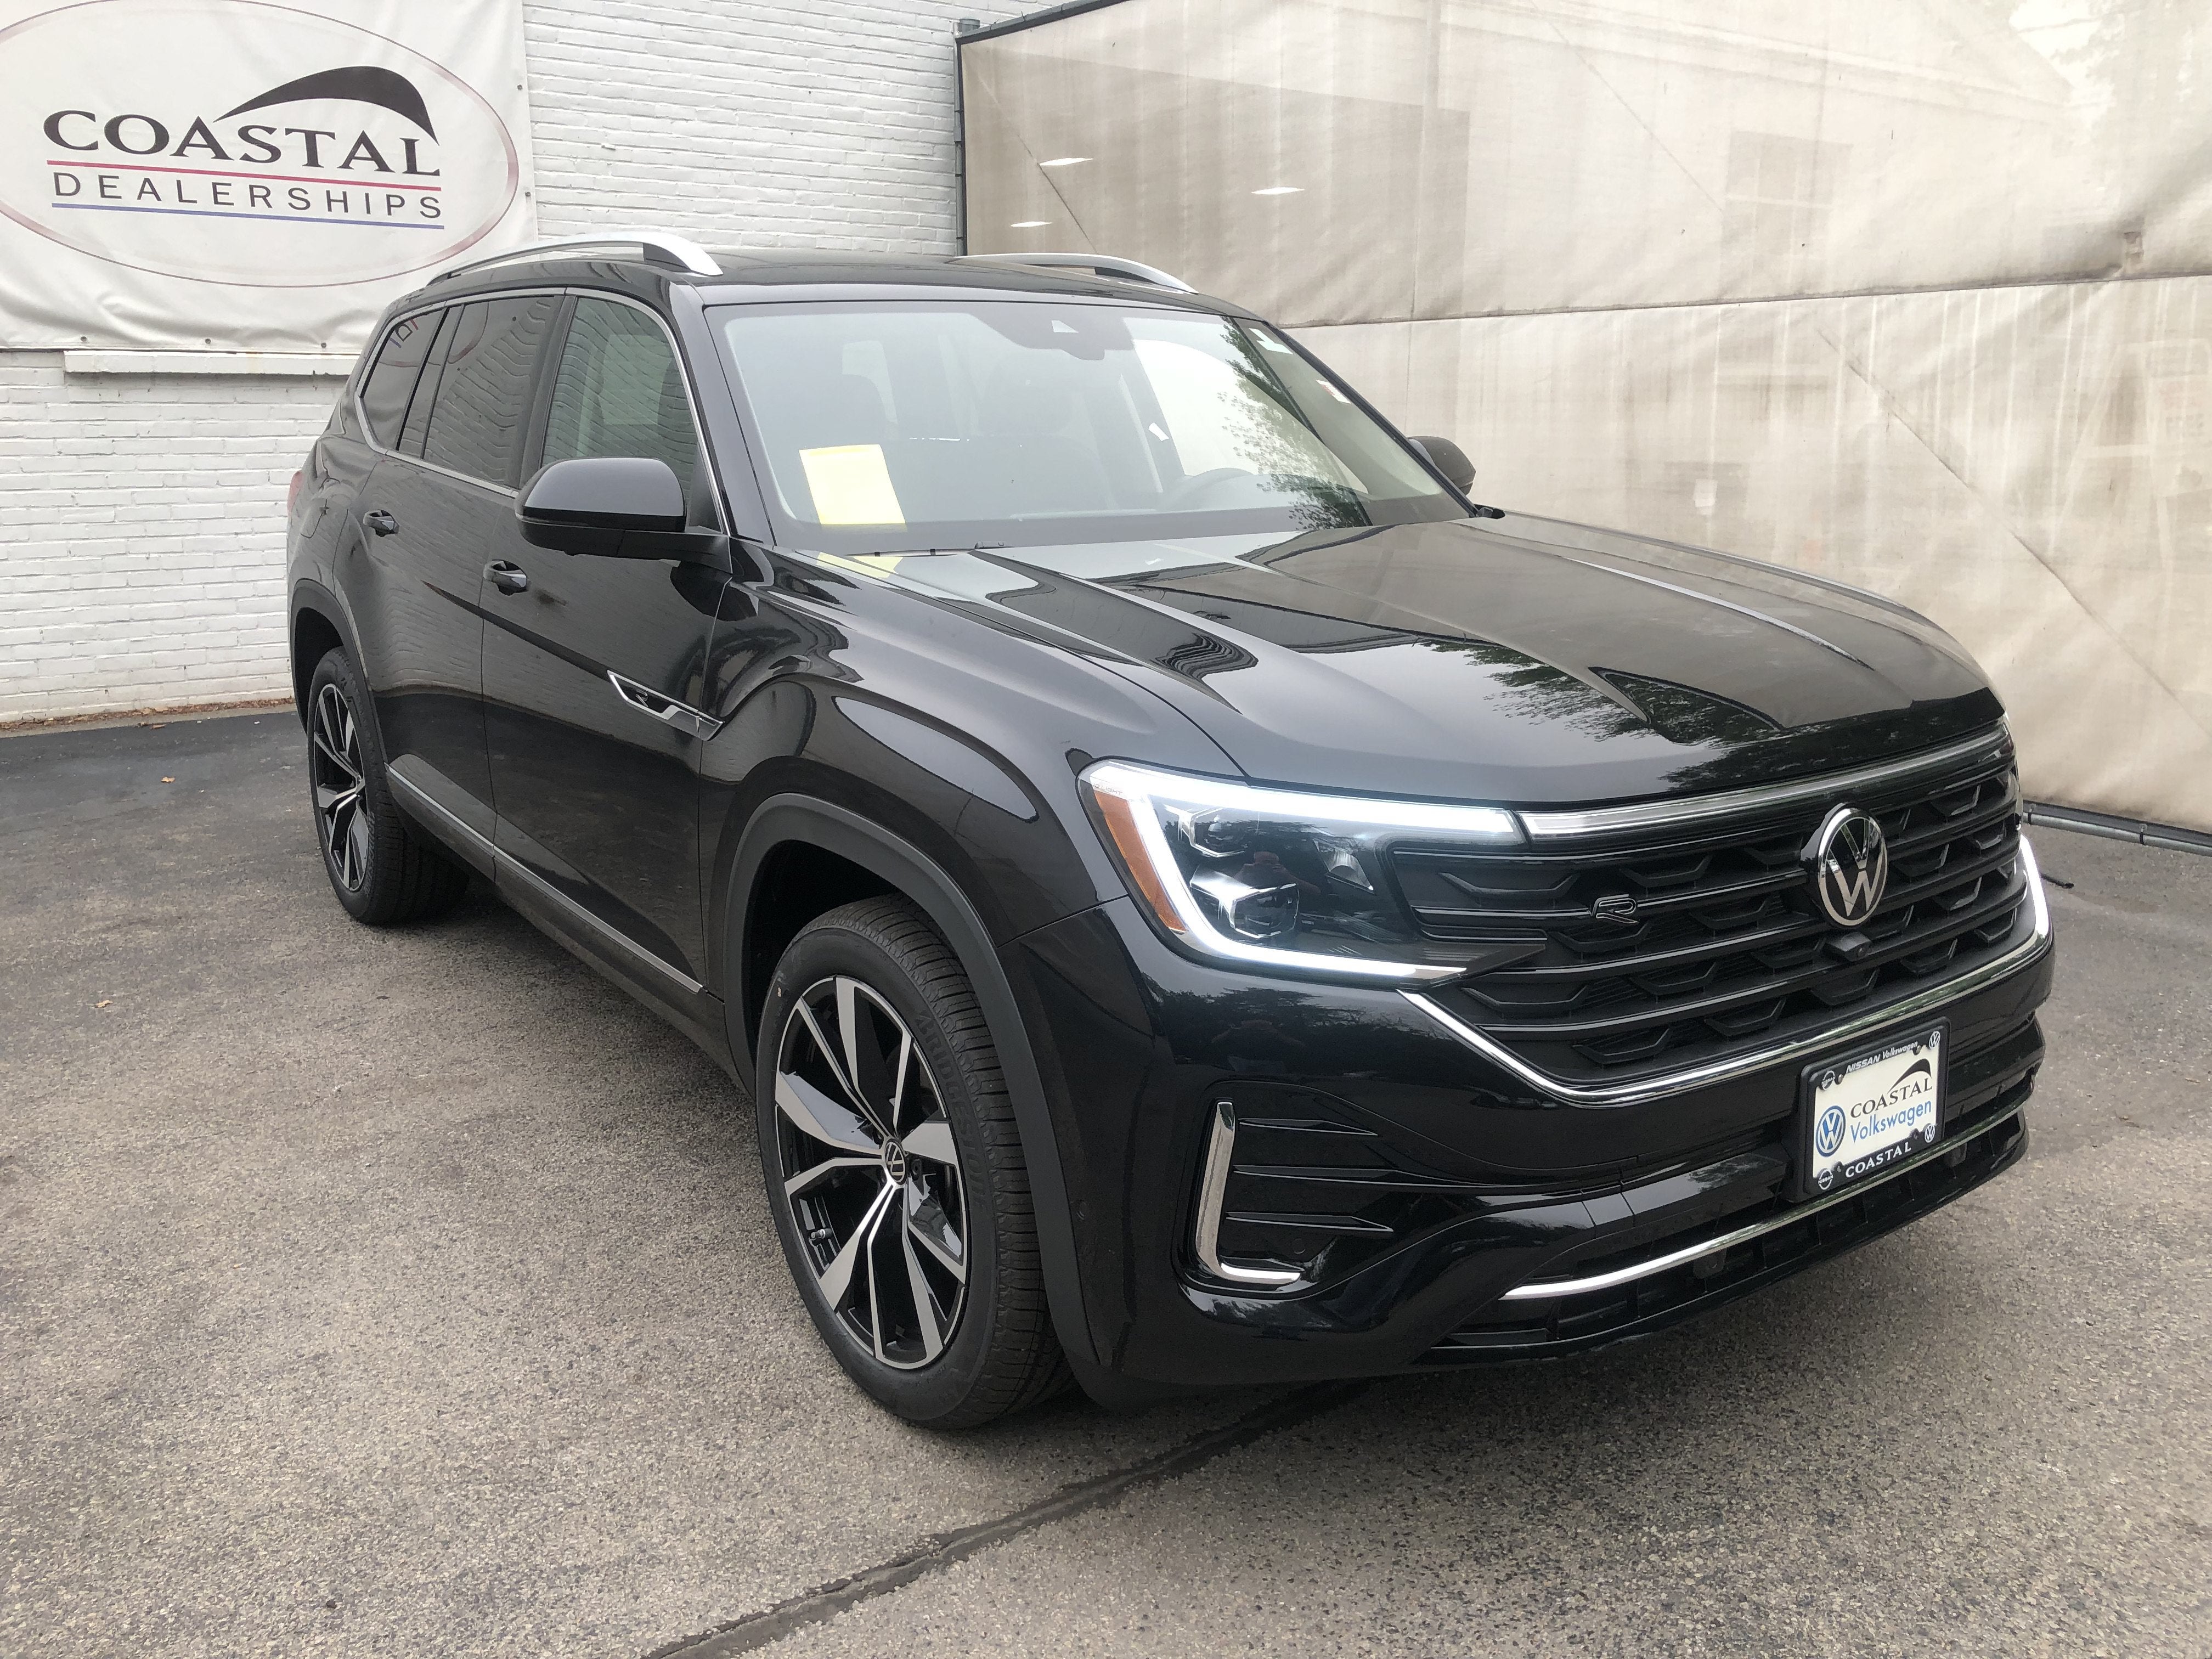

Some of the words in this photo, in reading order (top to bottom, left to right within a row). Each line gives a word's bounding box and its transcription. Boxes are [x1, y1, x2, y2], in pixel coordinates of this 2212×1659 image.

[43, 110, 441, 177] COASTAL
[53, 172, 441, 219] DEALERSHIPS
[1846, 1054, 1881, 1074] NISSAN
[1882, 1041, 1918, 1059] Volkswagen
[1850, 1077, 1933, 1118] COASTAL
[1850, 1101, 1932, 1143] Volkswagen
[1846, 1142, 1911, 1178] COASTAL
